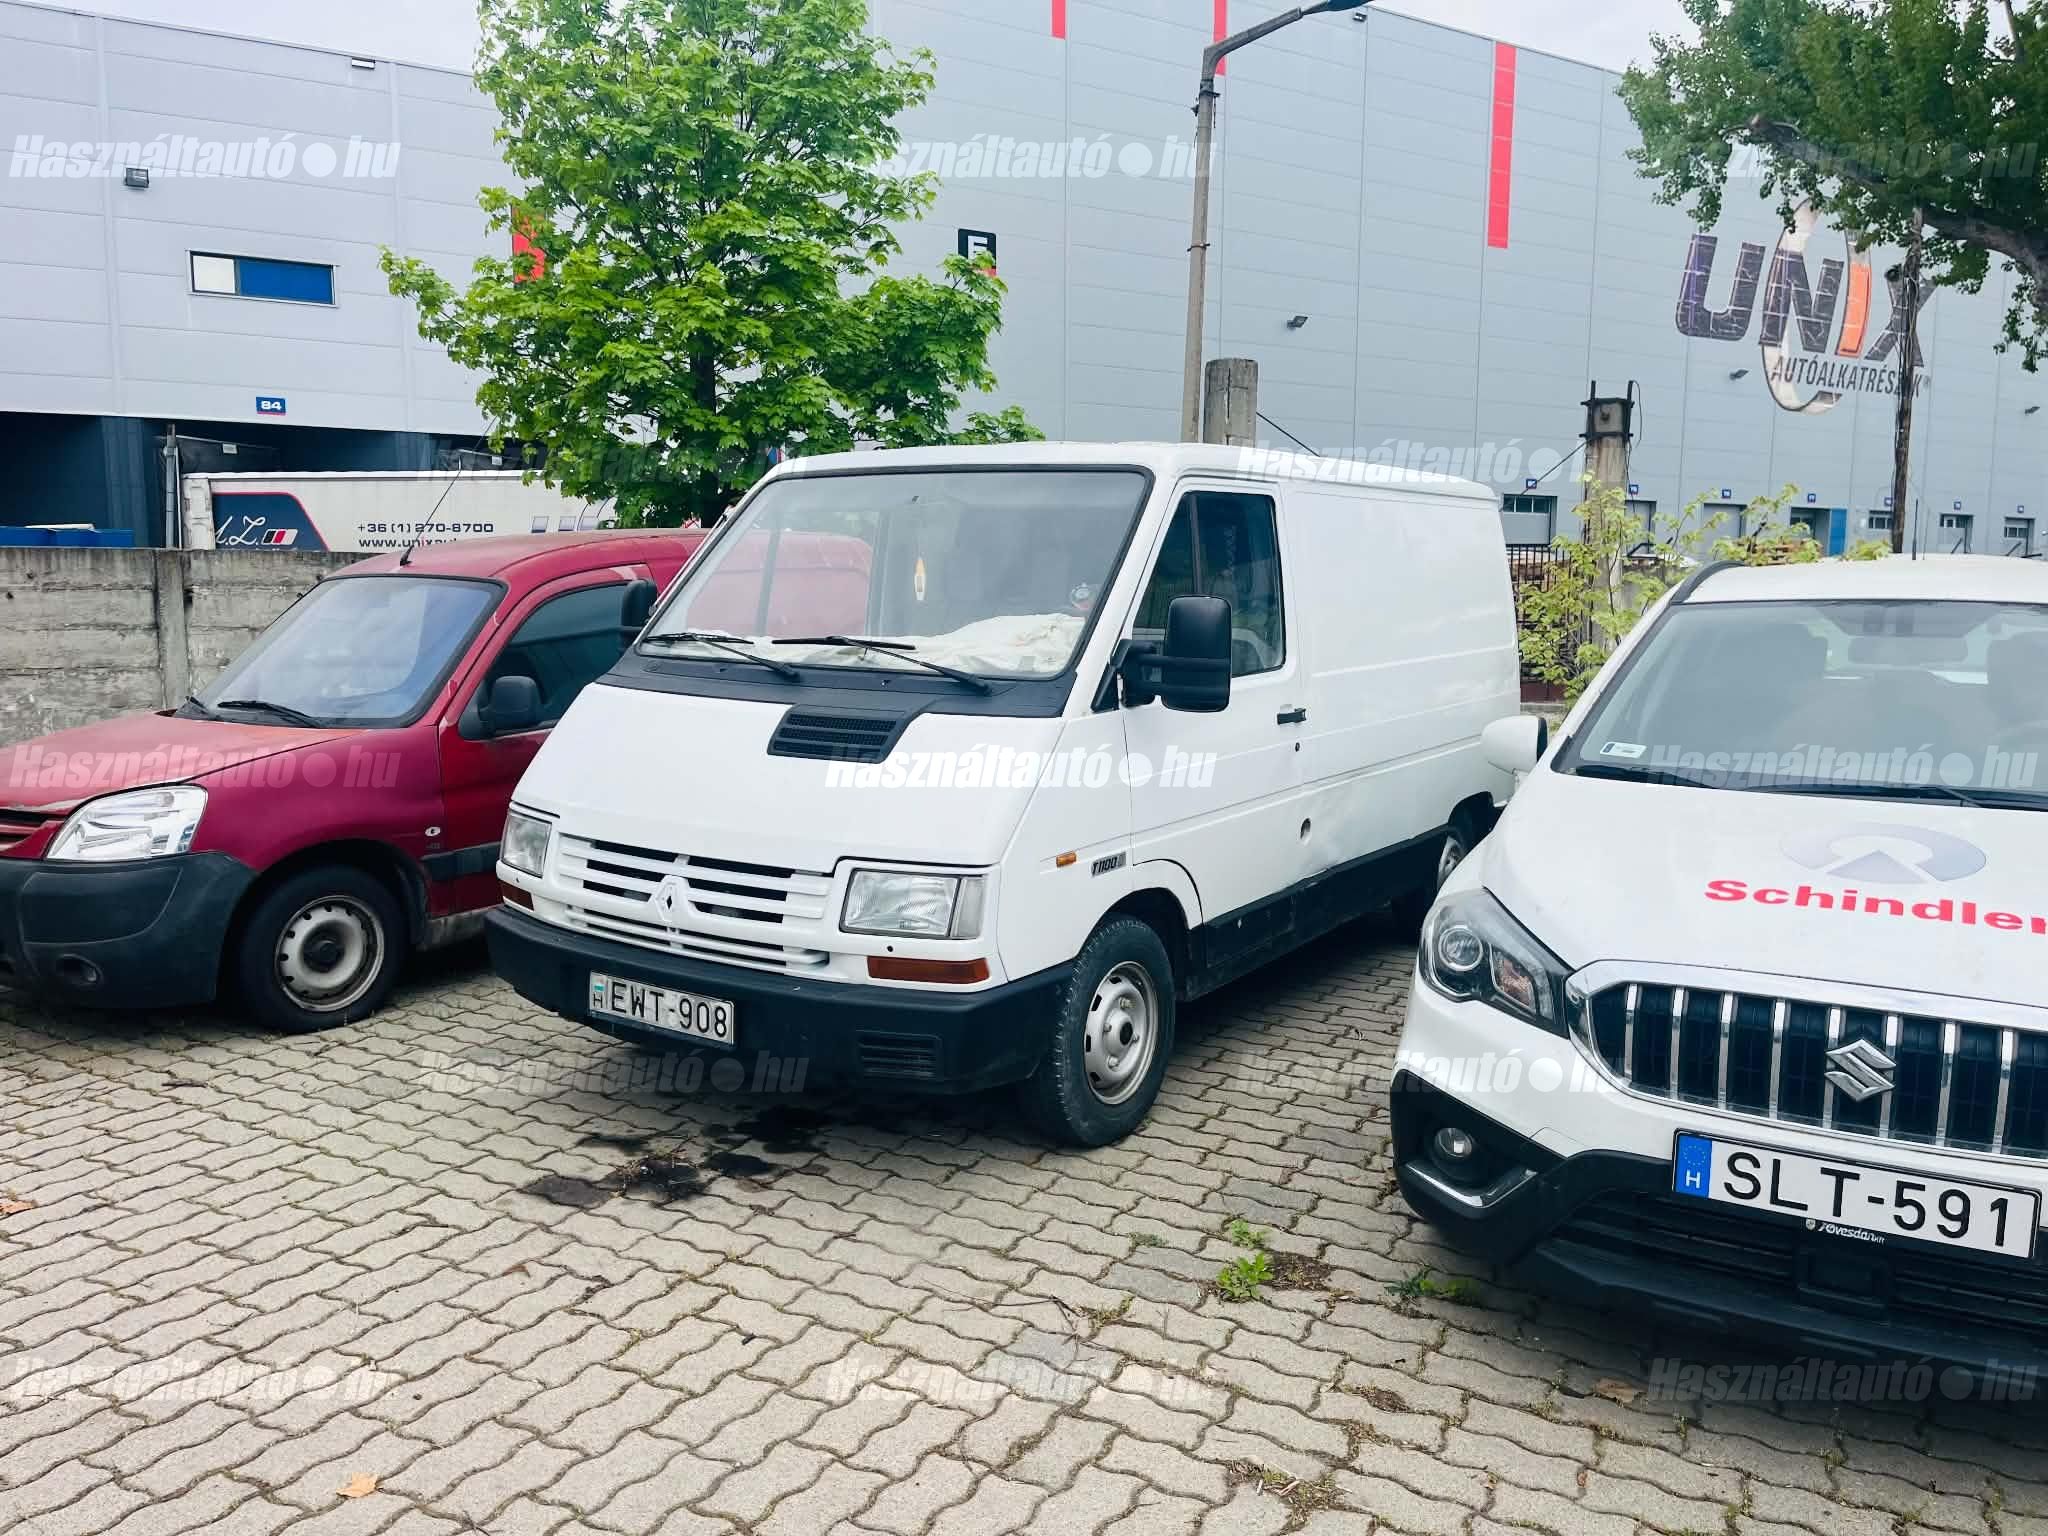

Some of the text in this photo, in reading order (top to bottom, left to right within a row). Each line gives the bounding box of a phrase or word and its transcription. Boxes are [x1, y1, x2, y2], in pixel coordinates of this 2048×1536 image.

[1675, 233, 1936, 368] UNIX
[357, 523, 494, 533] +36 (1) 270-8700
[612, 981, 727, 1038] EWT-908
[1723, 1150, 2010, 1247] SLT-591
